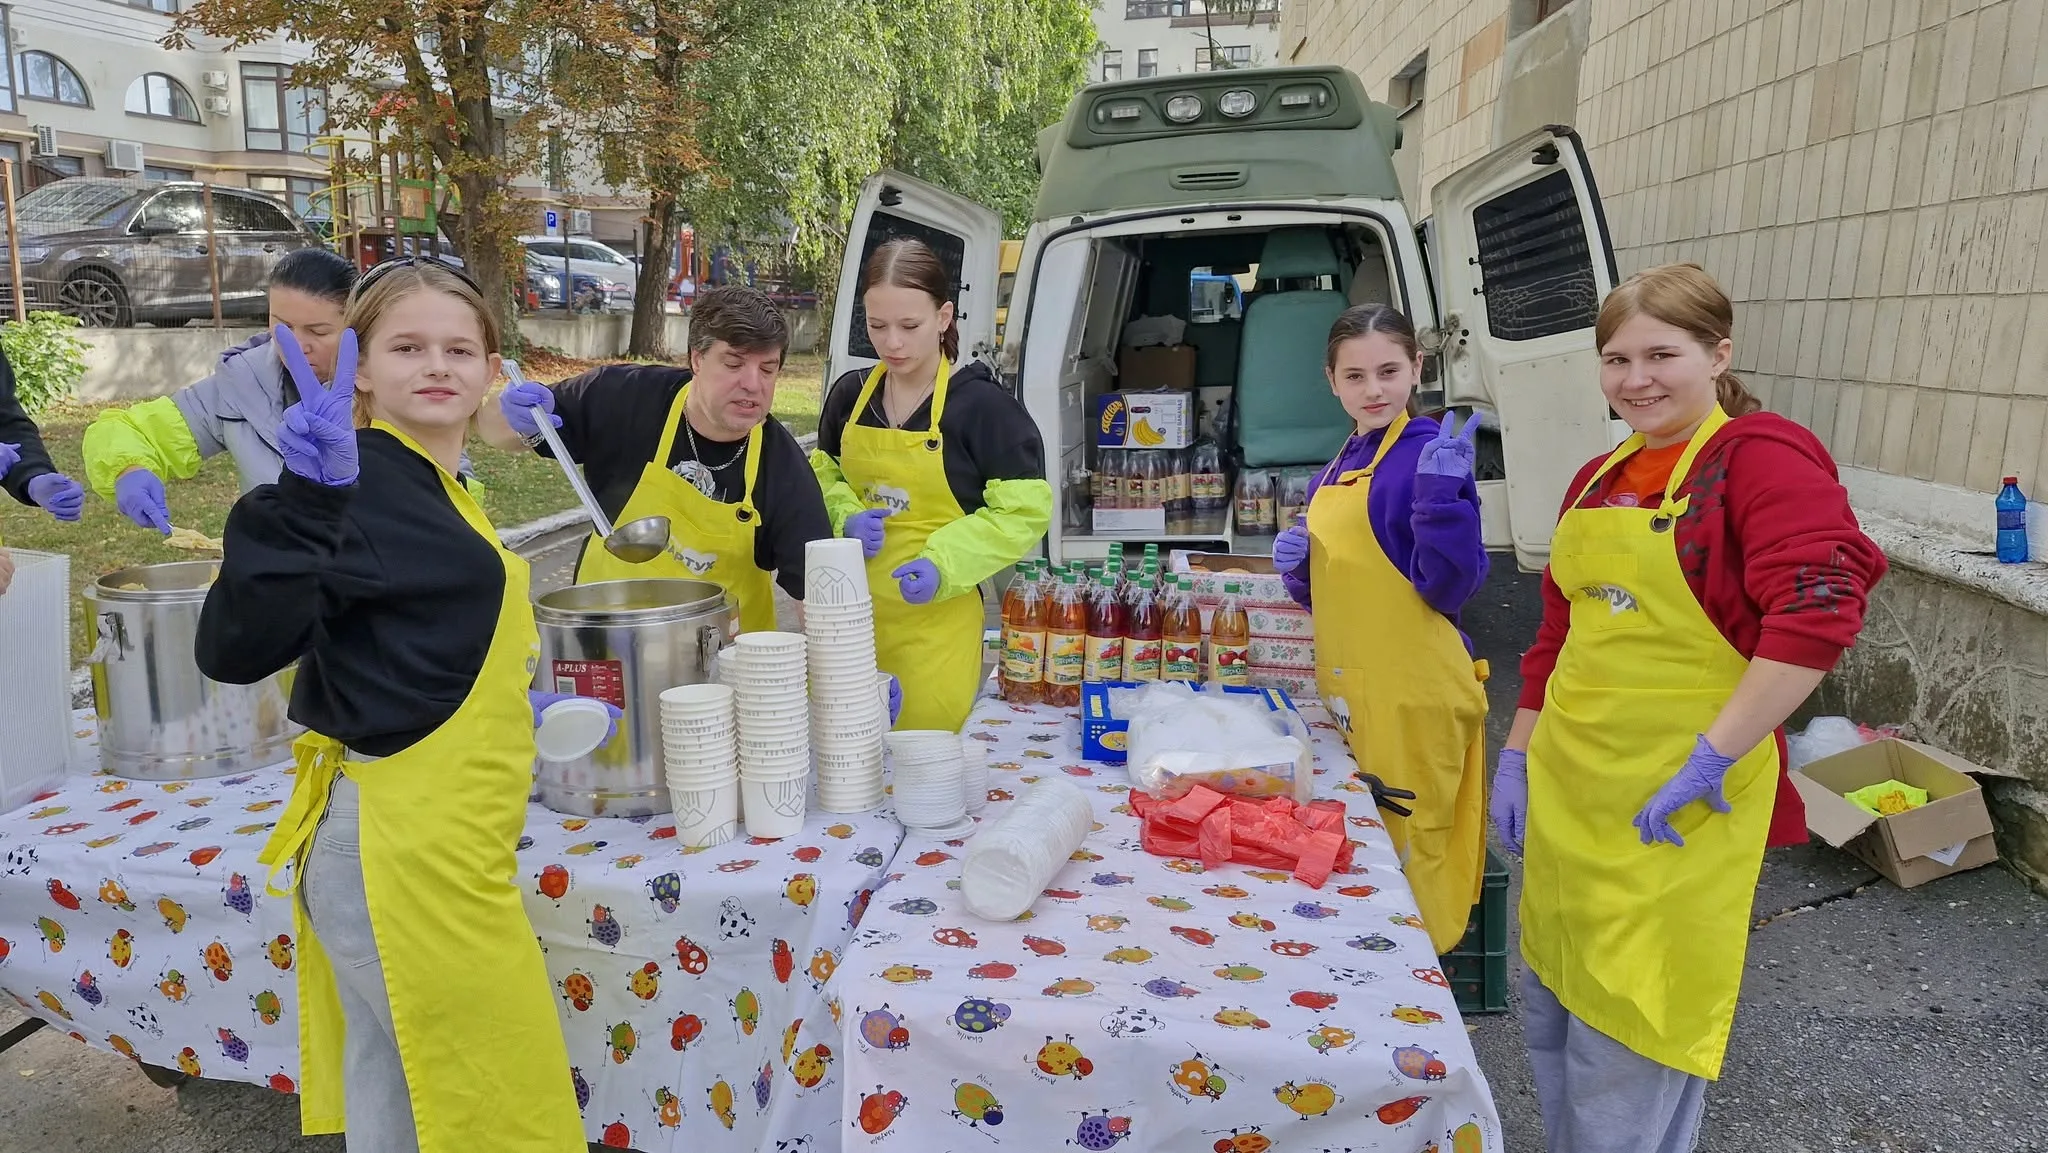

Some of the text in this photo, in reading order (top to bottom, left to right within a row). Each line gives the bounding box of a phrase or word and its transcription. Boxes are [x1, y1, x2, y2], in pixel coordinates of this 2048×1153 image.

[548, 213, 556, 225] P
[556, 663, 588, 673] A-PLUS
[956, 1030, 984, 1044] Charlie
[857, 1037, 870, 1054] Tom
[976, 1072, 993, 1088] Alice
[1305, 1074, 1337, 1090] Victoria
[868, 1128, 897, 1145] Natalia
